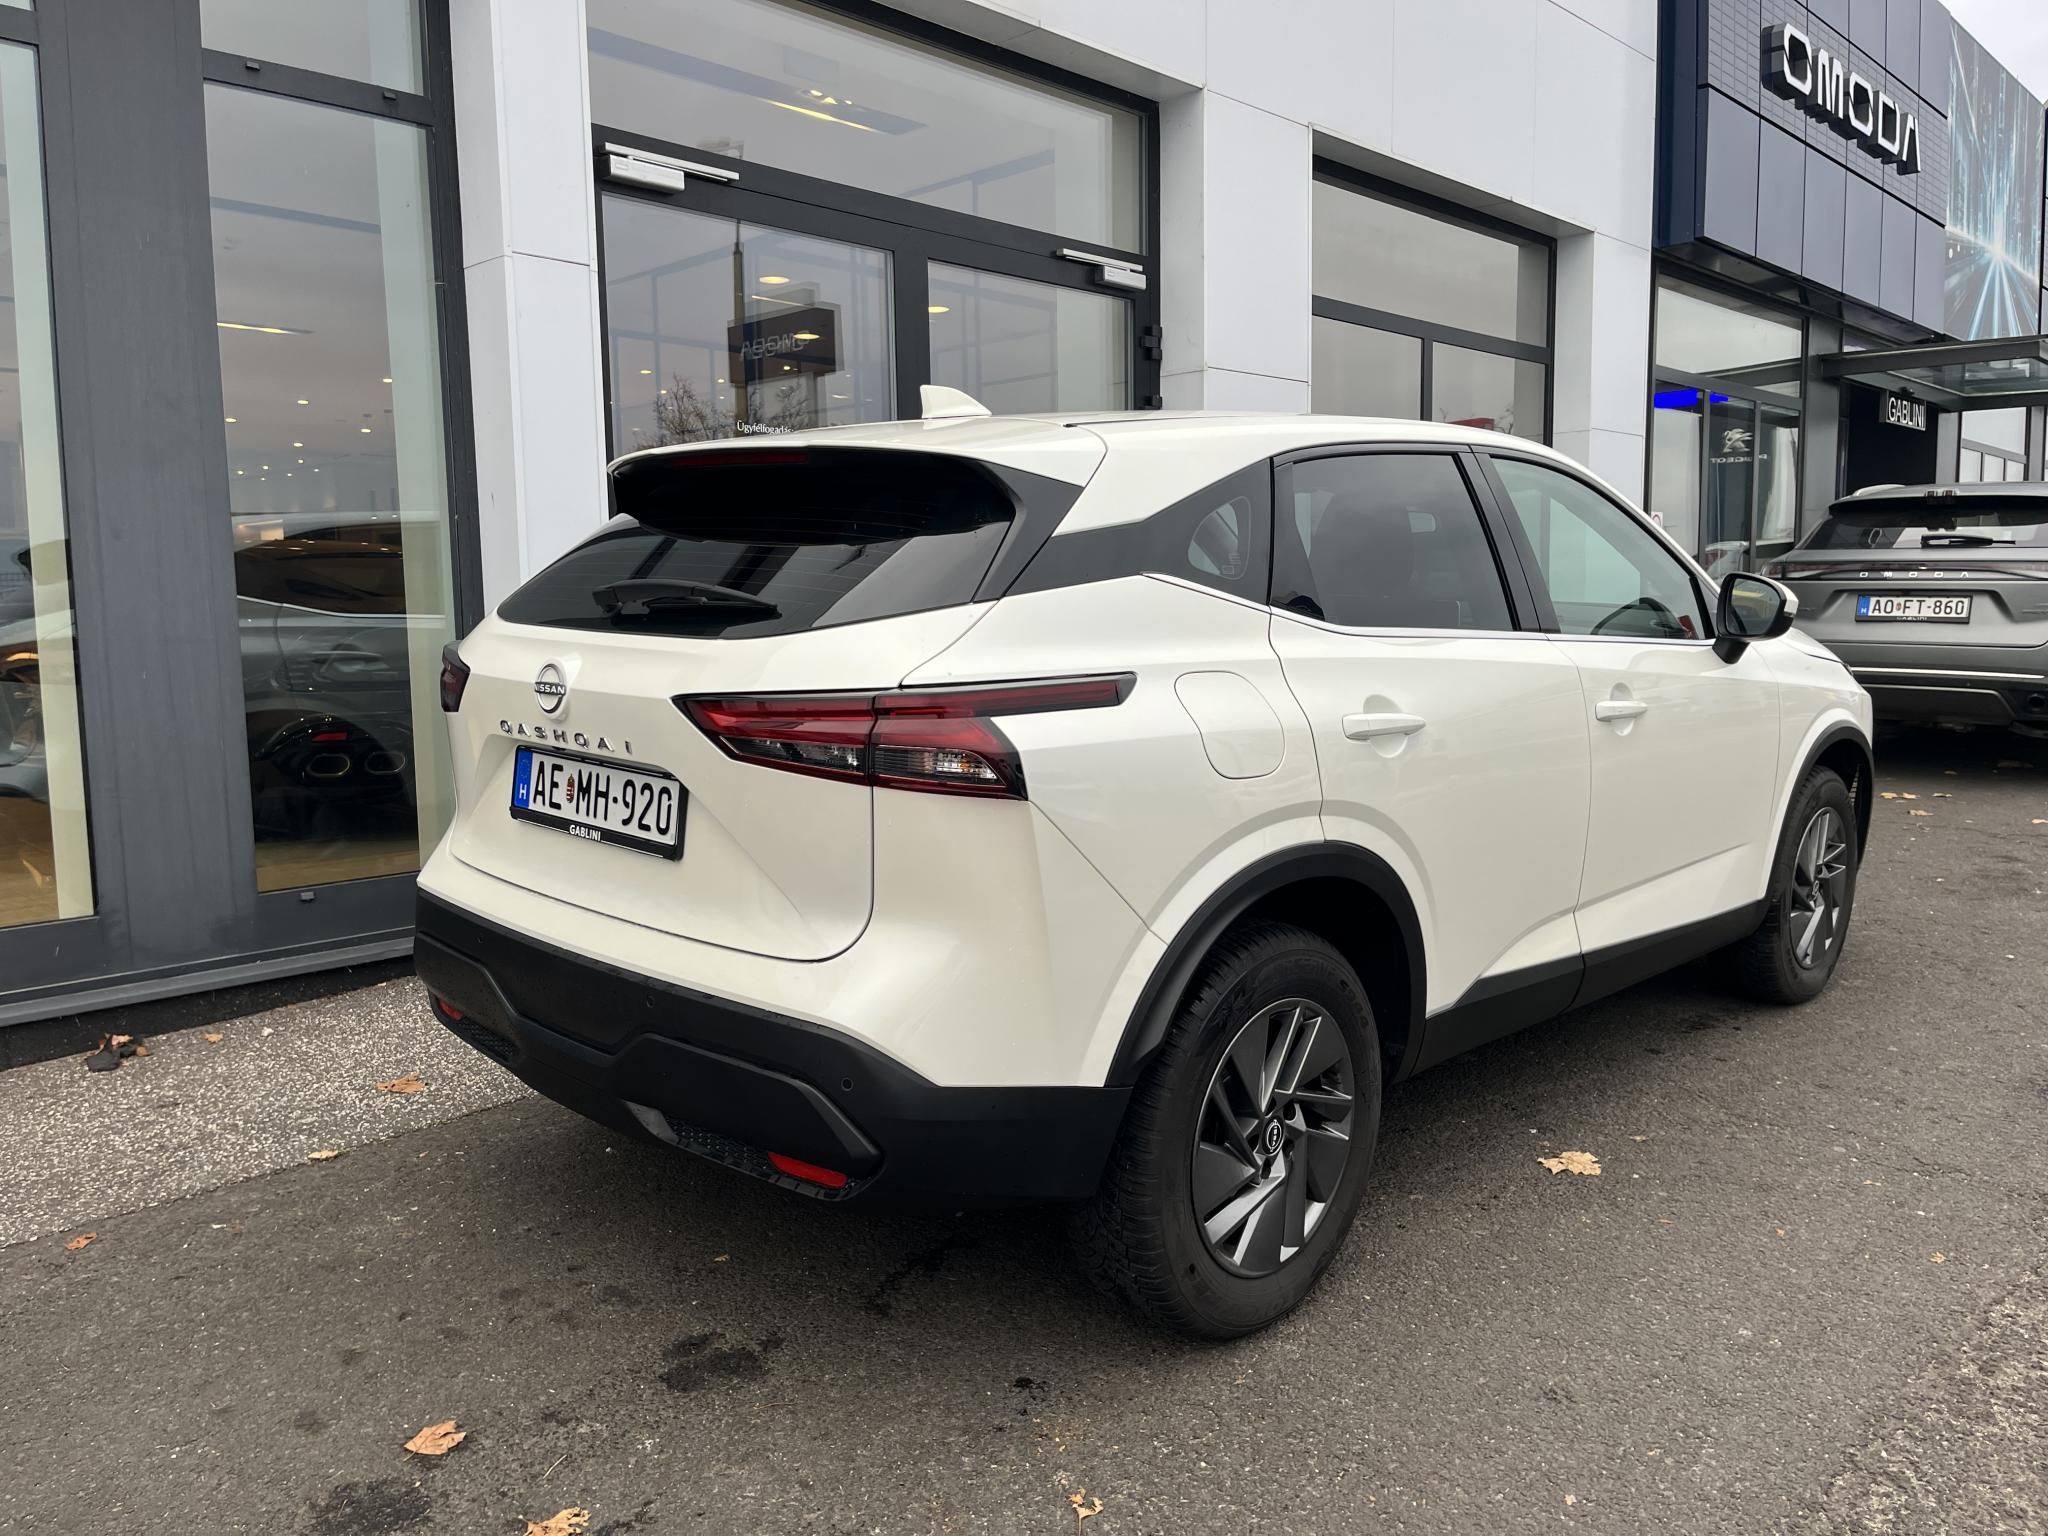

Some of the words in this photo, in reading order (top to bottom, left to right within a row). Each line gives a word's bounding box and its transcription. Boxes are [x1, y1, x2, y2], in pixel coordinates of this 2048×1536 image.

[1783, 22, 1921, 172] OMODA
[1888, 396, 1924, 429] GABLINI
[1872, 599, 1894, 614] AO
[1902, 599, 1965, 616] FT-860
[534, 682, 566, 696] NISSAN
[499, 719, 633, 755] QASHQAI
[519, 783, 528, 800] H
[533, 760, 564, 811] AE
[569, 824, 601, 842] GABLINI
